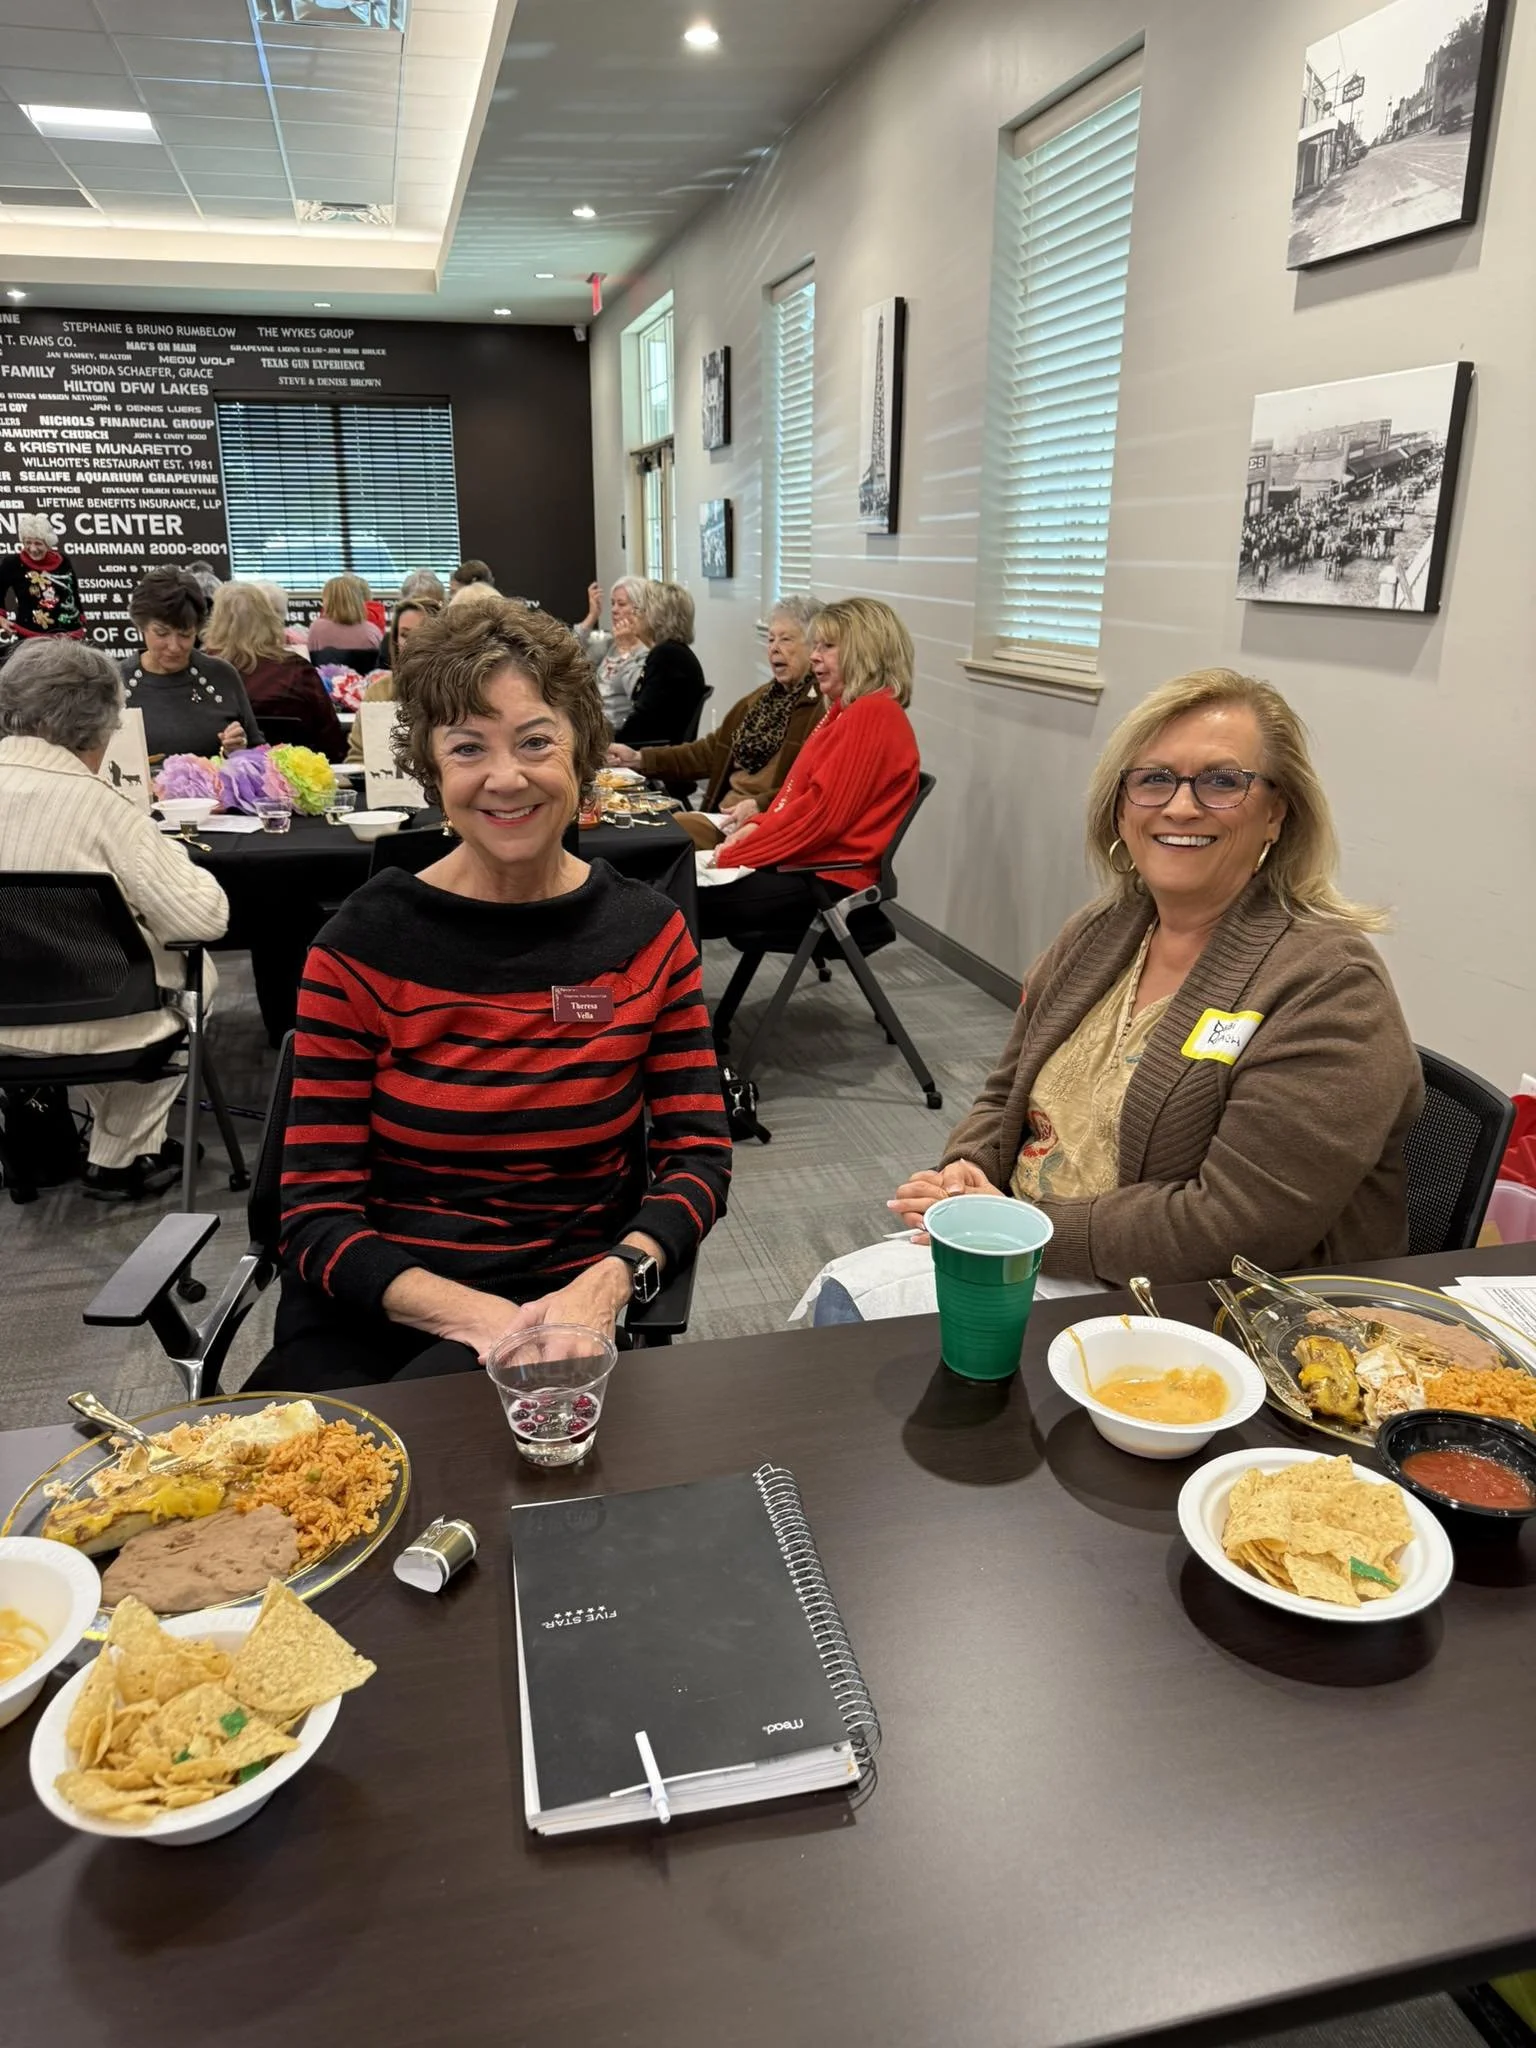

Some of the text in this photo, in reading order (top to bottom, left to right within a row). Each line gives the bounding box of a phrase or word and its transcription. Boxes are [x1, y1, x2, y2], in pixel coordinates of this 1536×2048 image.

[62, 321, 236, 337] STEPHANIE & BRUNO RUMBELOW
[257, 327, 354, 339] THE WYKES GROUP
[5, 335, 16, 345] T.
[19, 335, 54, 346] EVANS
[57, 336, 76, 347] CO.
[126, 341, 197, 352] MAC'S ON MAIN
[230, 344, 274, 352] GRAPEVINE
[100, 352, 132, 360] REALTOR
[159, 356, 235, 366] MEOW WOLF
[261, 358, 365, 370] TEXAS GUN EXPERIENCE
[1, 365, 56, 378] FAMILY
[70, 364, 214, 379] SHONDA SCHAEFER, GRACE
[278, 376, 306, 385] STEVE
[317, 377, 348, 386] DENISE
[351, 378, 381, 387] BROWN
[63, 380, 209, 396] HILTON DFW LAKES
[89, 404, 111, 412] JAN
[126, 404, 164, 413] DENNIS
[167, 405, 202, 413] LUERS
[39, 415, 215, 429] NICHOLS FINANCIAL GROUP
[0, 429, 109, 440] MMUNITY CHURCH
[3, 441, 193, 456] & KRISTINE MUNARETTO
[22, 457, 213, 470] WILLHOITE'S RESTAURANT EST. 1981
[19, 471, 71, 482] SEALIFE
[76, 471, 144, 484] AQUARIUM
[148, 472, 219, 484] GRAPEVINE
[14, 485, 81, 494] ASSISTANCE
[172, 487, 217, 495] COLLEYVILLE
[36, 497, 222, 510] LIFETIME BENEFITS INSURANCE, LLP
[74, 513, 184, 535] CENTER
[64, 543, 145, 555] CHAIRMAN
[149, 543, 228, 555] 2000-2001
[99, 565, 127, 573] LEON
[78, 578, 133, 588] ESSIONALS
[112, 593, 123, 603] &
[93, 627, 119, 642] OF
[571, 1002, 598, 1010] Theresa
[585, 1610, 617, 1622] FIVE
